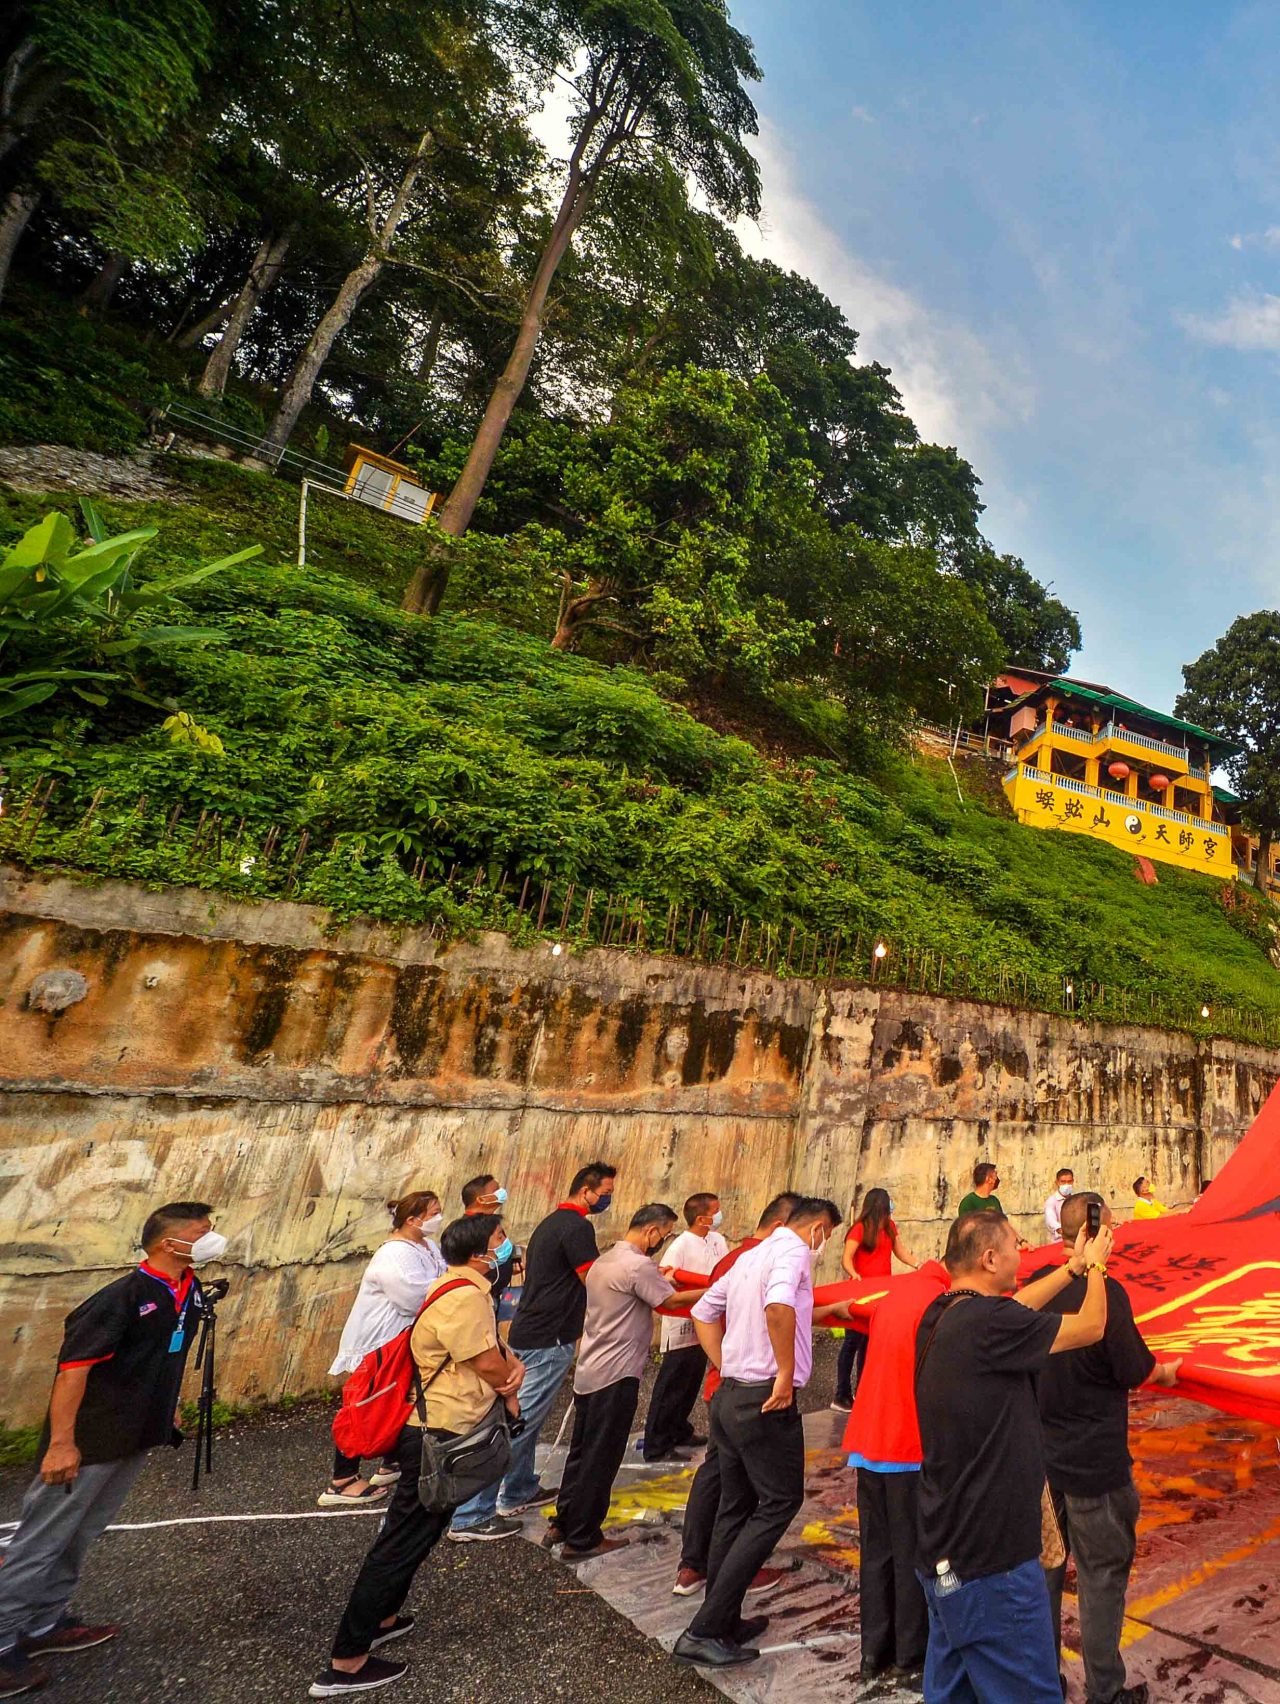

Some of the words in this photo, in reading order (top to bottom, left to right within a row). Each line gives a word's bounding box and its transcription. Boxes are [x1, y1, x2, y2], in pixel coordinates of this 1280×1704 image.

[1035, 788, 1111, 828] 蜈蚣山
[1154, 824, 1218, 859] 天師宮
